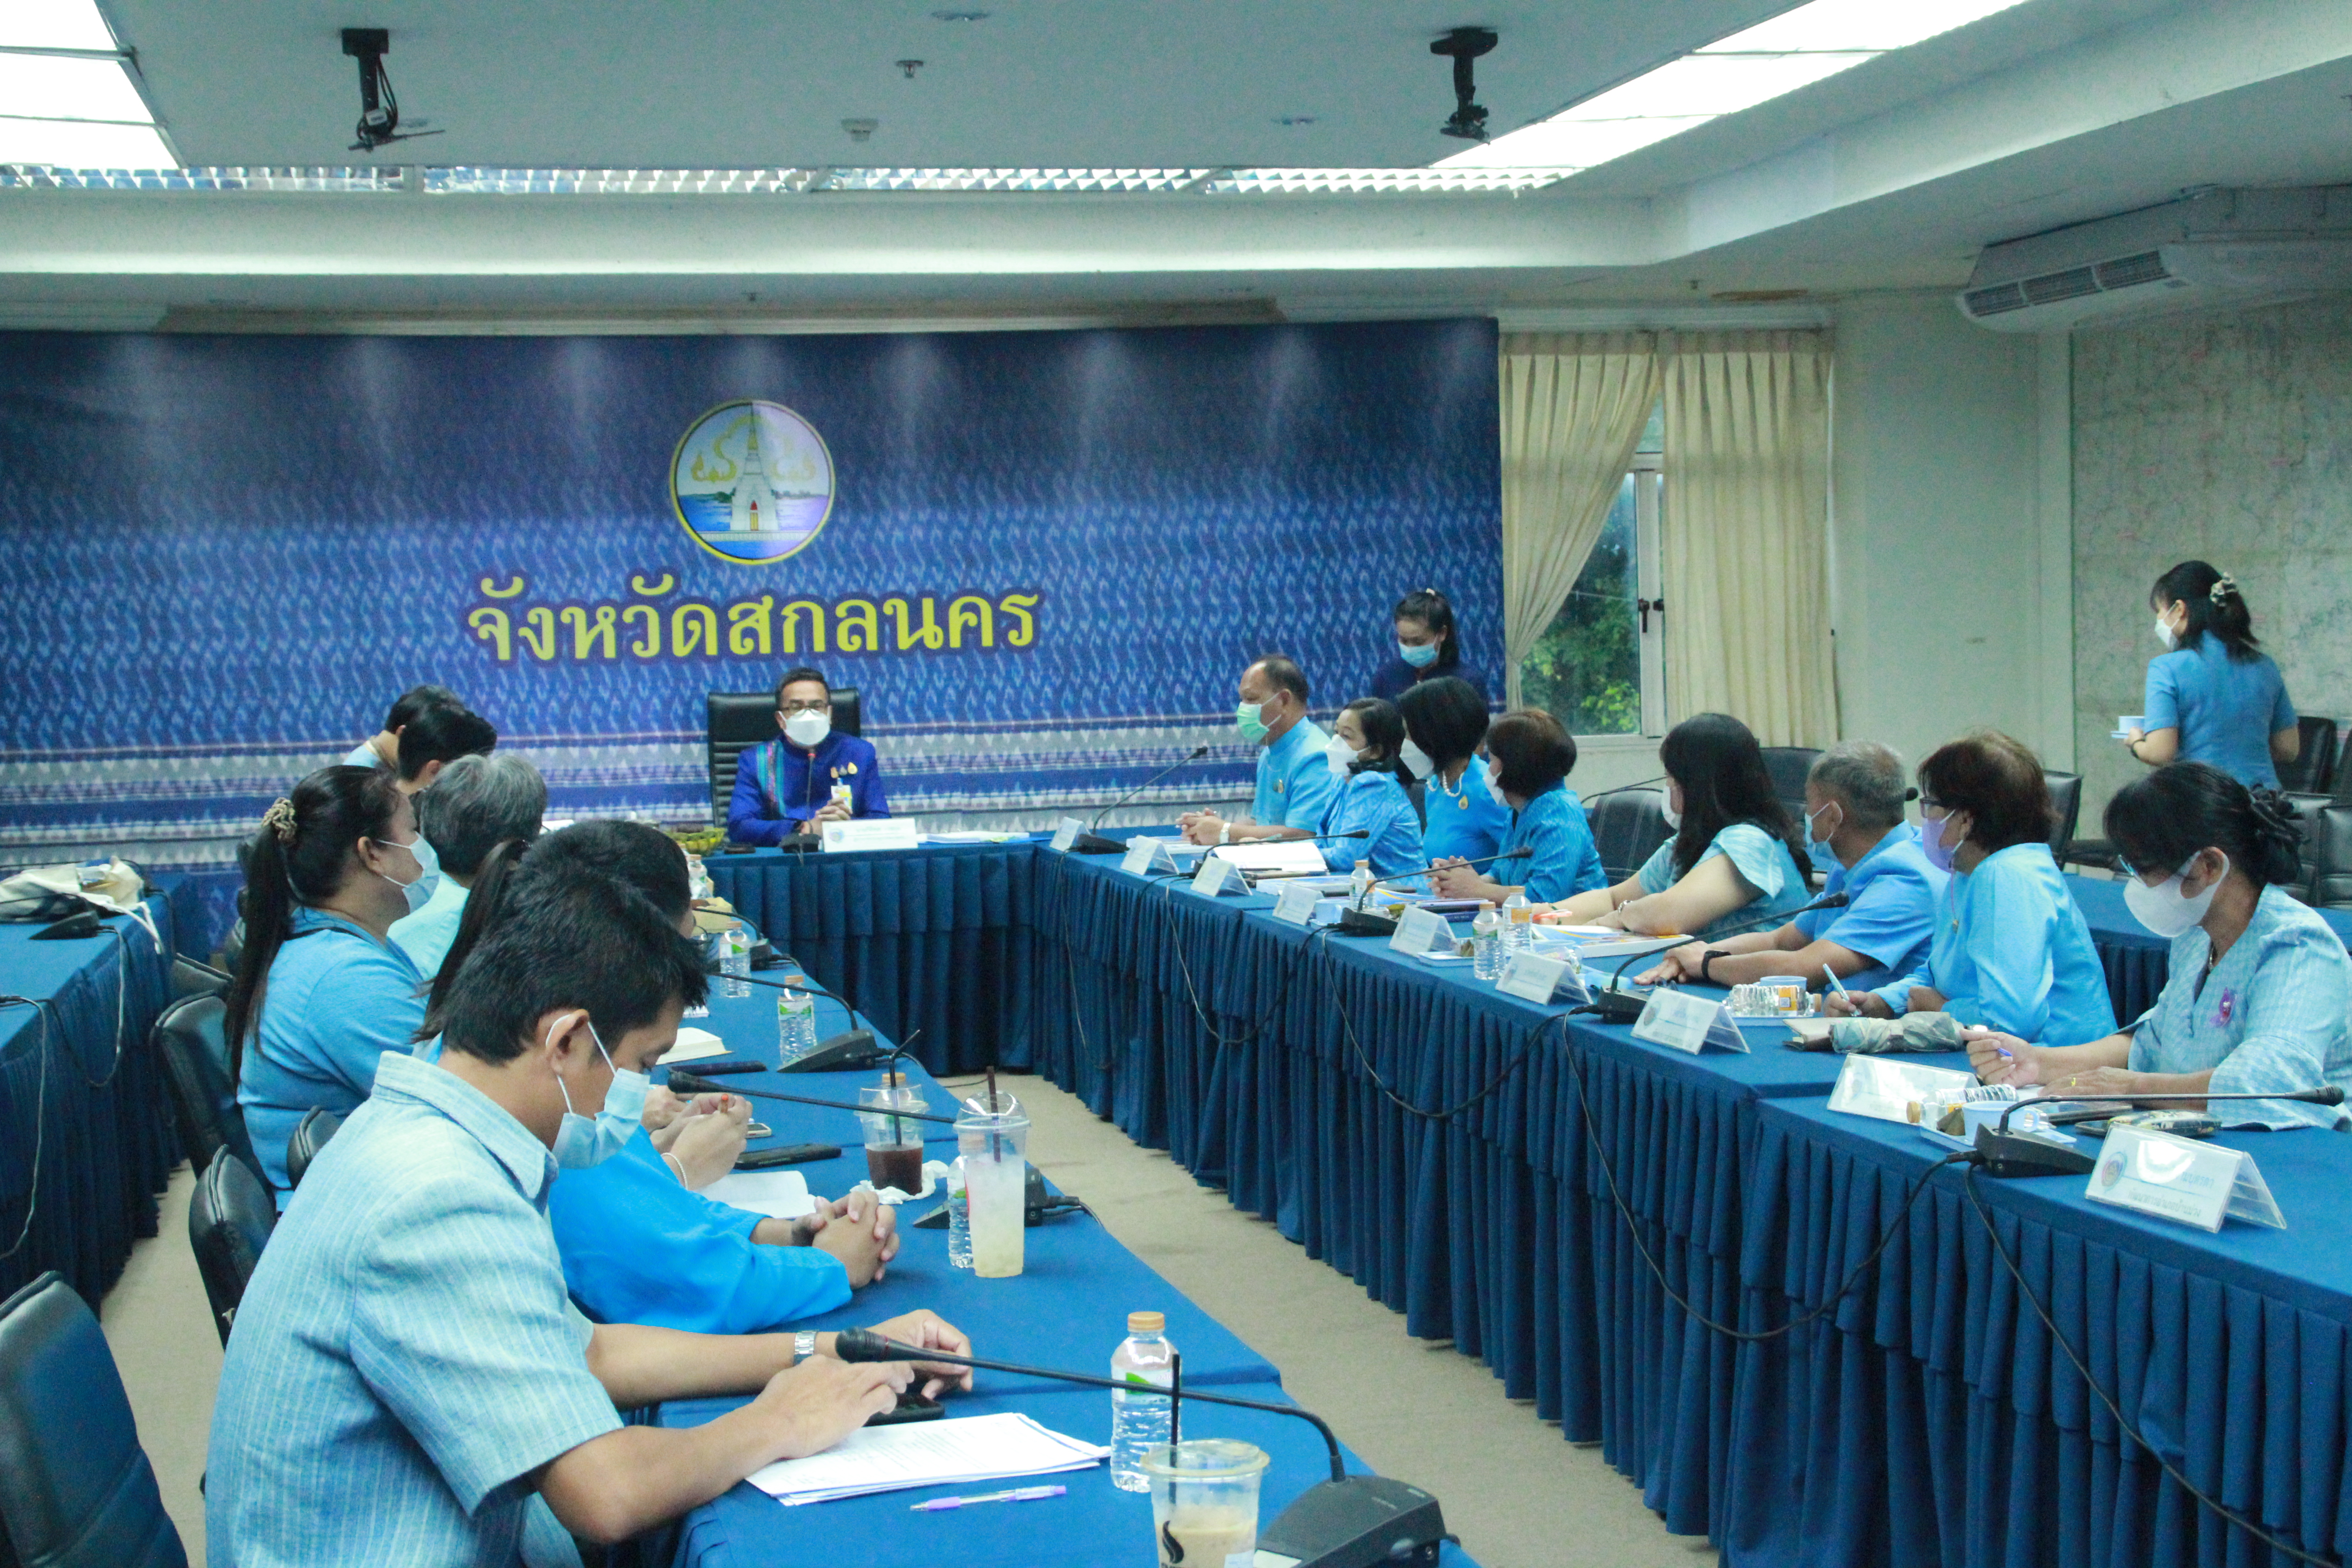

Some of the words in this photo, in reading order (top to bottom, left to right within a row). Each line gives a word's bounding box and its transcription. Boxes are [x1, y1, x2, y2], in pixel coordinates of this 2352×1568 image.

[468, 573, 1039, 661] จังหวัดสกลนคร
